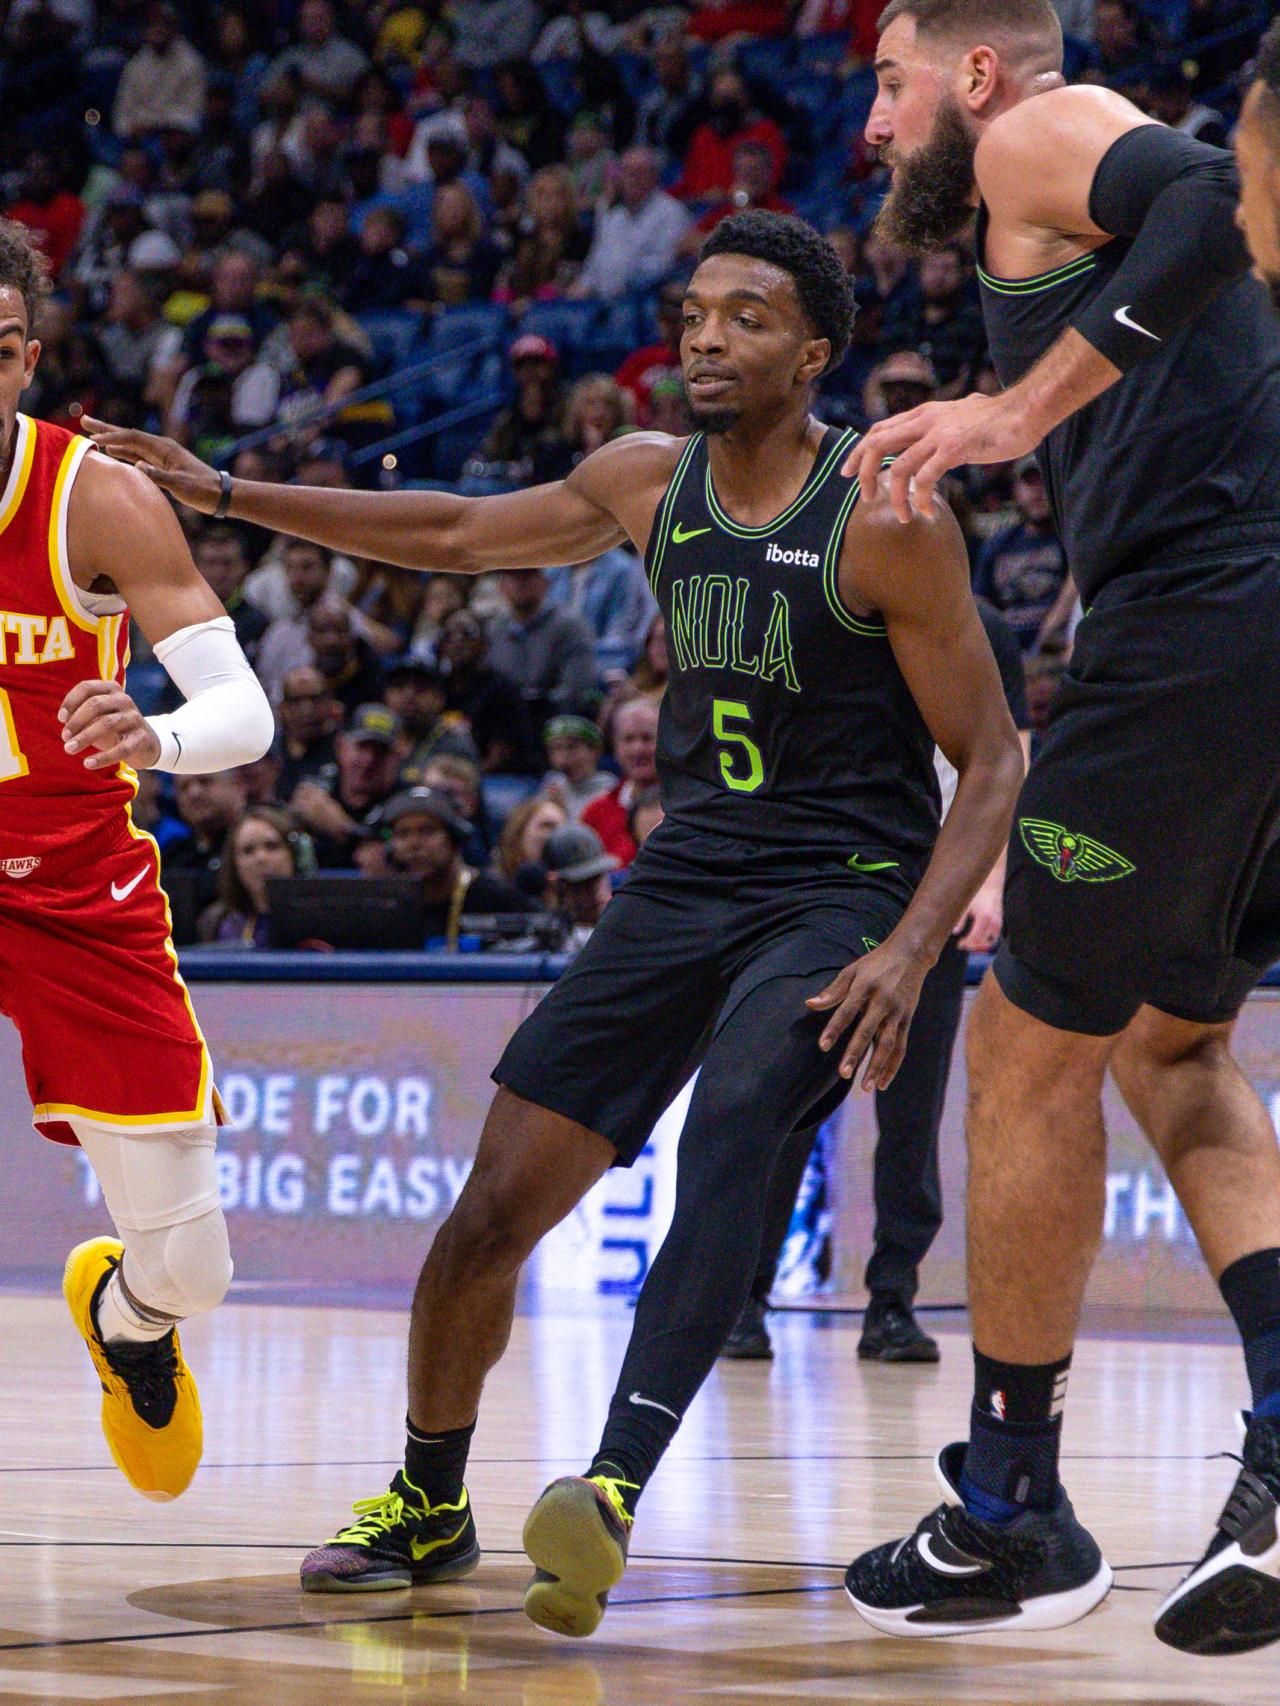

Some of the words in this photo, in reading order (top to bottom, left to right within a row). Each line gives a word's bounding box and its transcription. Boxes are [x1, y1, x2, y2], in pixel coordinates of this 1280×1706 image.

[766, 544, 820, 567] ibotta
[672, 574, 801, 692] NOLA
[713, 699, 765, 792] 5
[0, 856, 41, 871] HAWKS
[315, 1075, 432, 1136] FOR
[216, 1152, 305, 1213] BIG
[327, 1153, 474, 1217] EASY
[1104, 1172, 1196, 1239] TH
